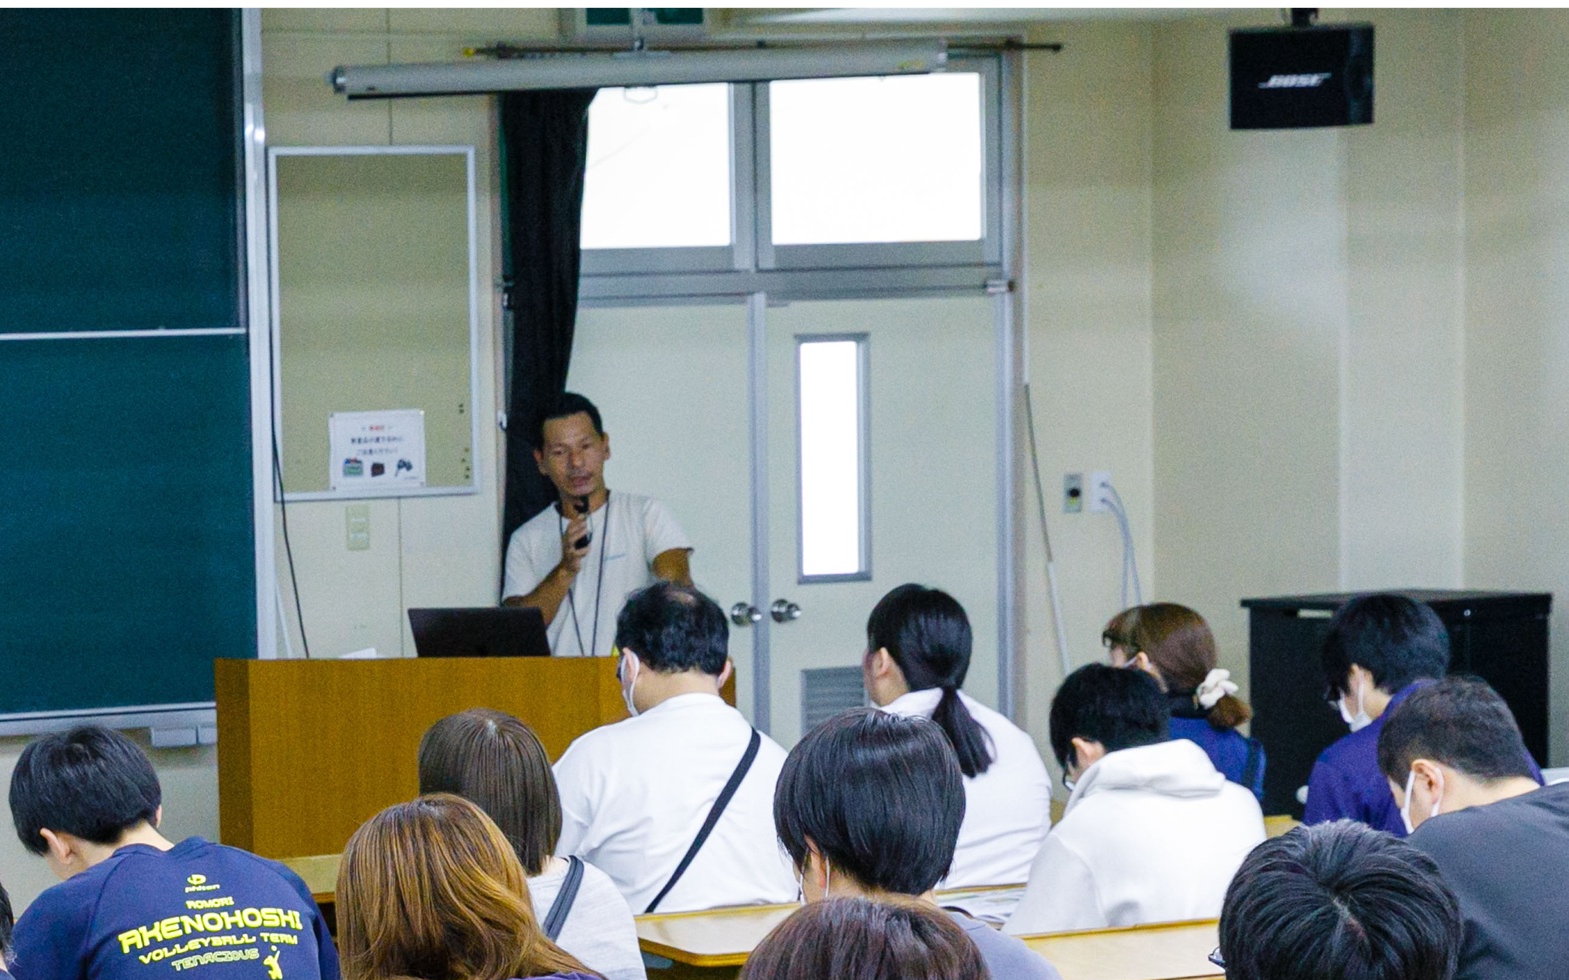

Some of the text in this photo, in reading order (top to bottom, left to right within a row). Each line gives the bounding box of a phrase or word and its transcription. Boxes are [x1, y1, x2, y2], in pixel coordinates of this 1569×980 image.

[117, 907, 303, 954] AKENOHOSHI
[139, 931, 299, 965] VOLLEYBALL TEAM
[171, 947, 260, 973] TENACIOUS
